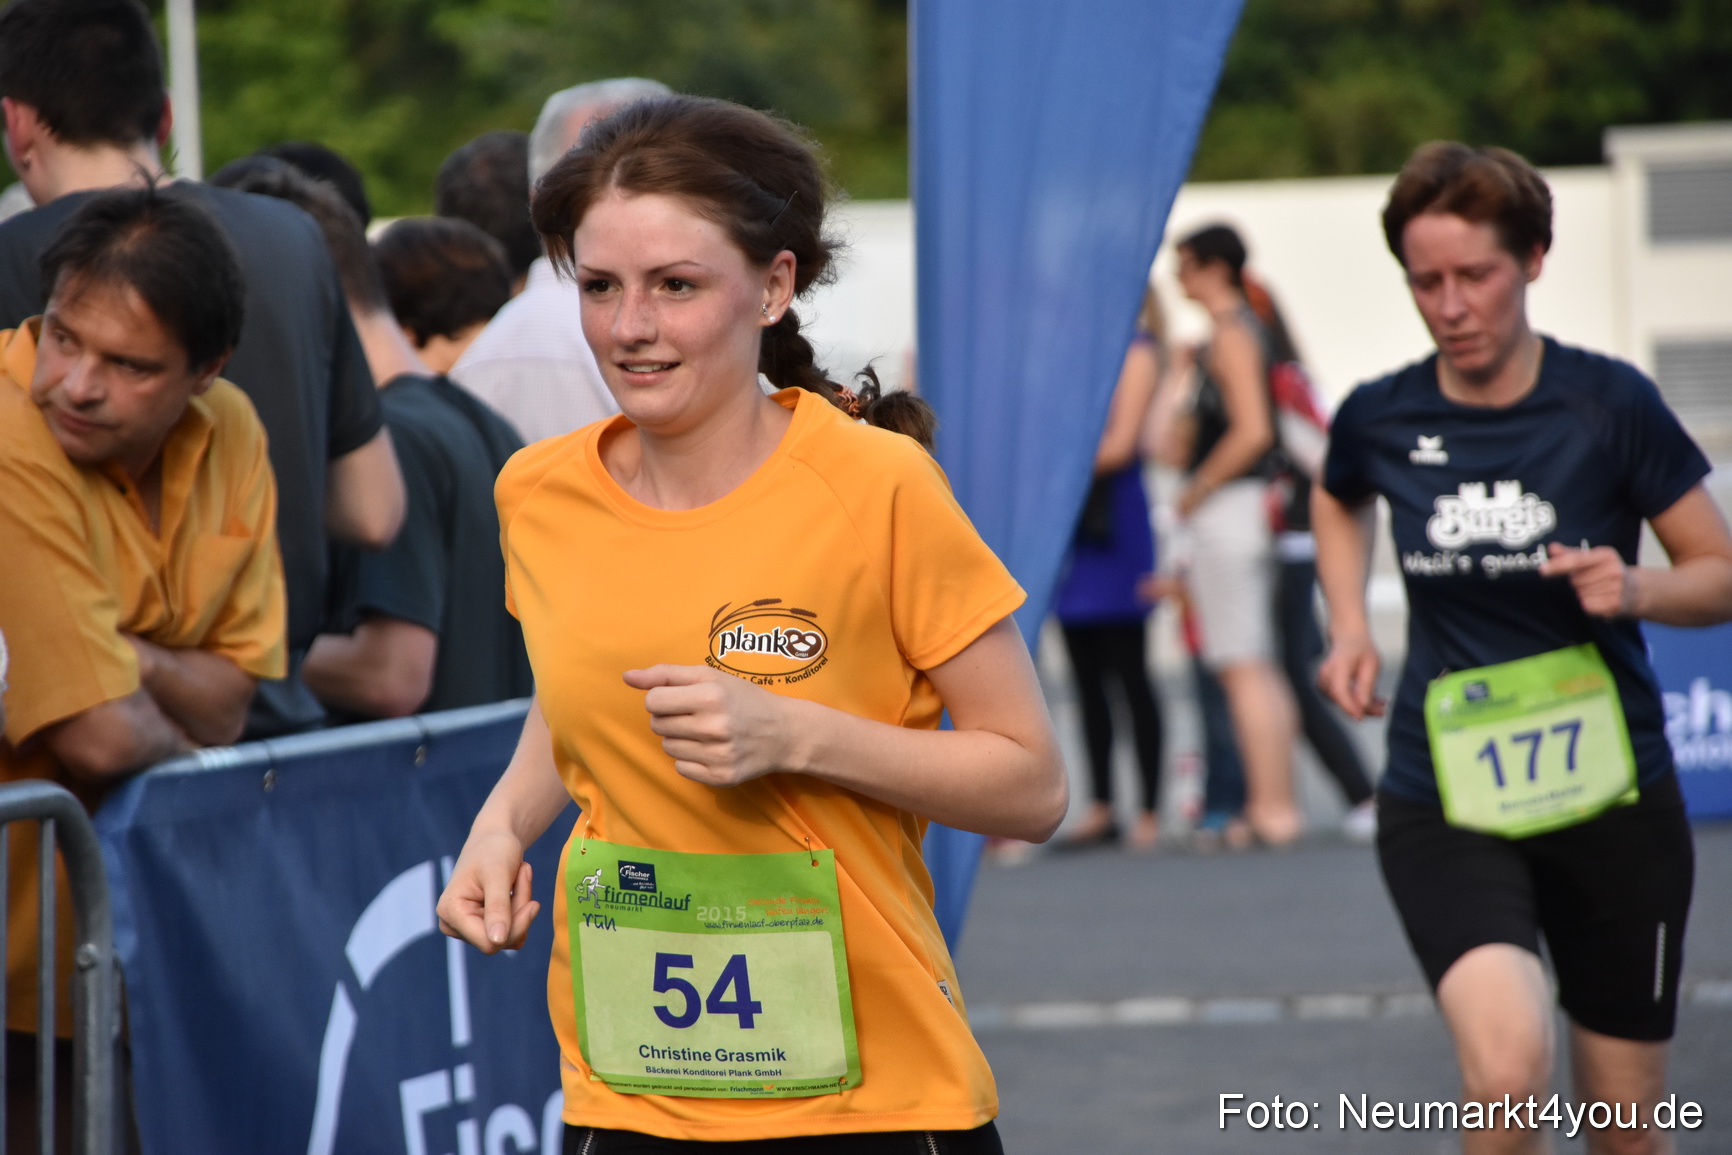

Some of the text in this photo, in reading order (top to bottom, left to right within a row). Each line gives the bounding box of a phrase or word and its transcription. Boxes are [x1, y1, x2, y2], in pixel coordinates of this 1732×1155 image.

[718, 624, 792, 659] plank
[785, 656, 829, 684] Konditorei
[1477, 717, 1582, 789] 177
[625, 869, 650, 878] Fischer
[605, 886, 691, 911] firmenlauf
[605, 903, 643, 912] neumarkt
[697, 905, 747, 922] 2015
[653, 952, 762, 1029] 54
[638, 1044, 786, 1062] Christine Grasmik
[645, 1066, 782, 1077] Bäckerei Konditorei Plank GmbH
